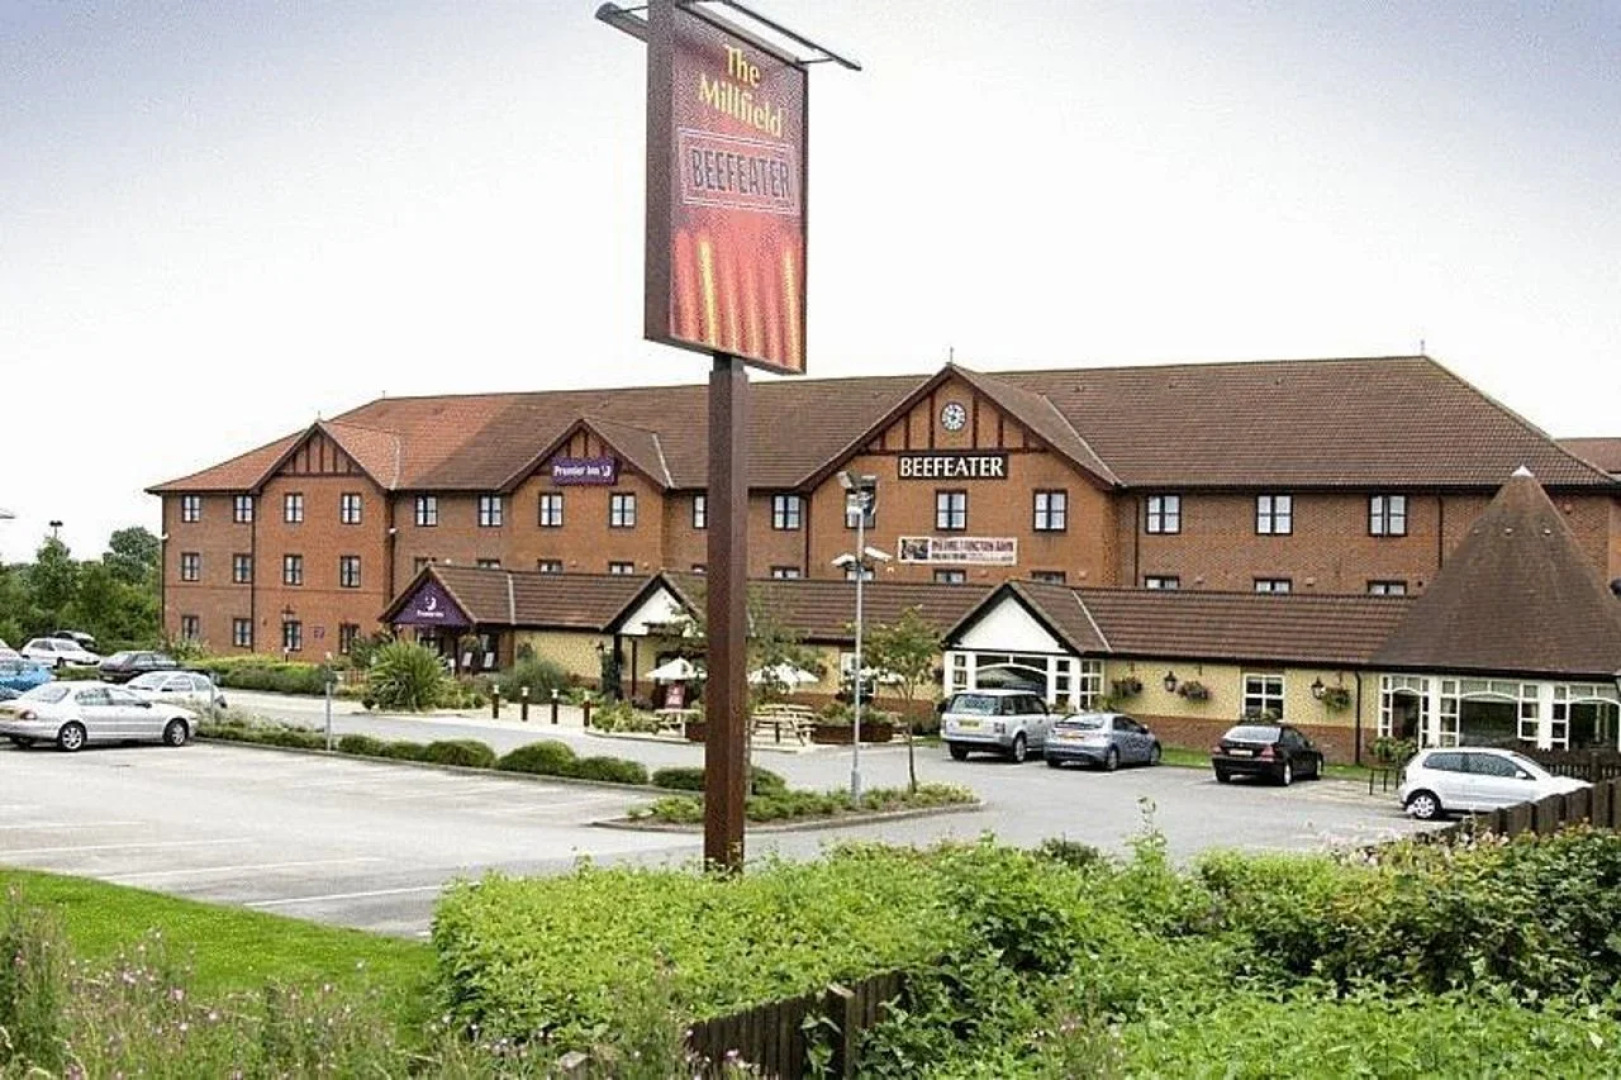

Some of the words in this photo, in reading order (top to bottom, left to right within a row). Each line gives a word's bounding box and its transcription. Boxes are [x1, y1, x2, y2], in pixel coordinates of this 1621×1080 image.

[724, 46, 760, 86] The
[699, 73, 782, 137] Millfield
[691, 149, 790, 198] BEEFEATER
[900, 457, 1004, 477] BEEFEATER
